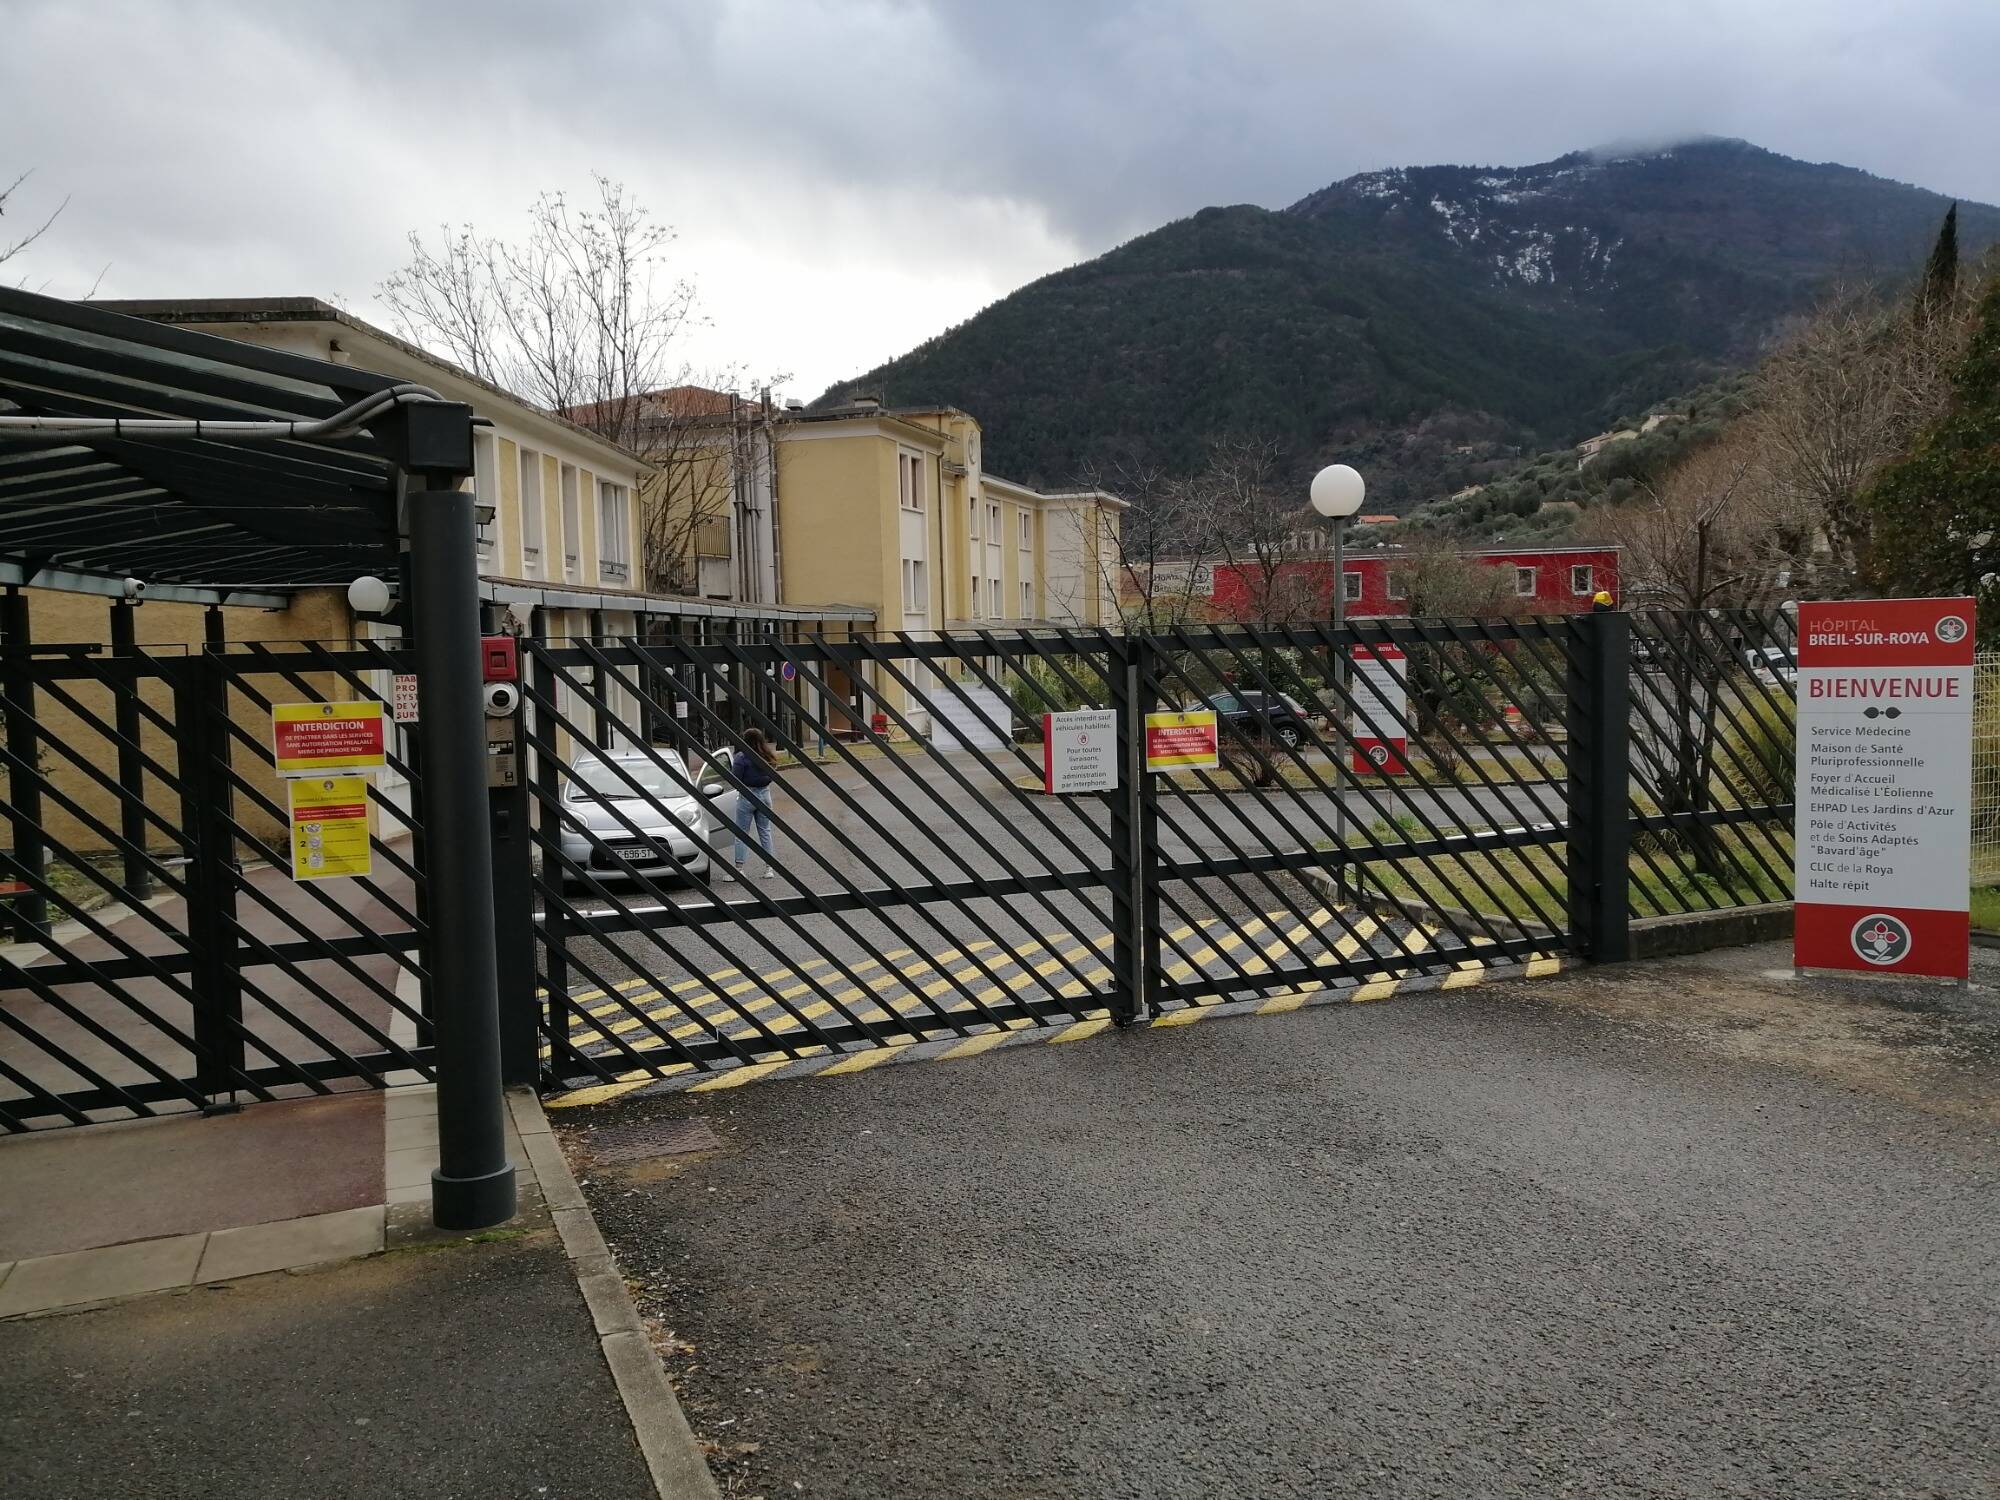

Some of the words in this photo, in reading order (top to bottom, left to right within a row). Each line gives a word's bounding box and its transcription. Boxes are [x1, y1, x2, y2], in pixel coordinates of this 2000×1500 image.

[1810, 618, 1880, 632] HÔPITAL
[1809, 632, 1929, 646] BREIL-SUR-ROYA
[1810, 678, 1959, 698] BIENVENUE
[293, 721, 364, 732] INTERDICTION
[1158, 727, 1205, 736] INTERDICTION
[1811, 727, 1851, 736] Service
[1855, 727, 1911, 737] Médecine
[1811, 744, 1851, 753] Maison
[1855, 744, 1868, 753] de
[1871, 743, 1903, 754] Santé
[1811, 757, 1925, 768] Pluriprofessionnelle
[1811, 774, 1841, 785] Foyer
[1844, 774, 1895, 784] d'Accueil
[1811, 786, 1870, 797] Médicalisé
[1874, 786, 1934, 798] L'Éolienne
[1810, 803, 1848, 813] EHPAD
[1851, 804, 1869, 814] Les
[1872, 804, 1913, 815] Jardins
[1916, 805, 1955, 816] d'Azur
[1810, 820, 1834, 830] Pôle
[1837, 820, 1897, 831] d'Activités
[1810, 834, 1820, 842] et
[1823, 833, 1836, 843] de
[1838, 833, 1868, 844] Soins
[1871, 835, 1919, 847] Adaptés
[1810, 862, 1834, 872] CLIC
[1837, 863, 1850, 873] de
[1853, 864, 1862, 873] la
[1865, 864, 1894, 875] Roya
[1810, 879, 1839, 889] Halte
[1842, 880, 1869, 891] répit
